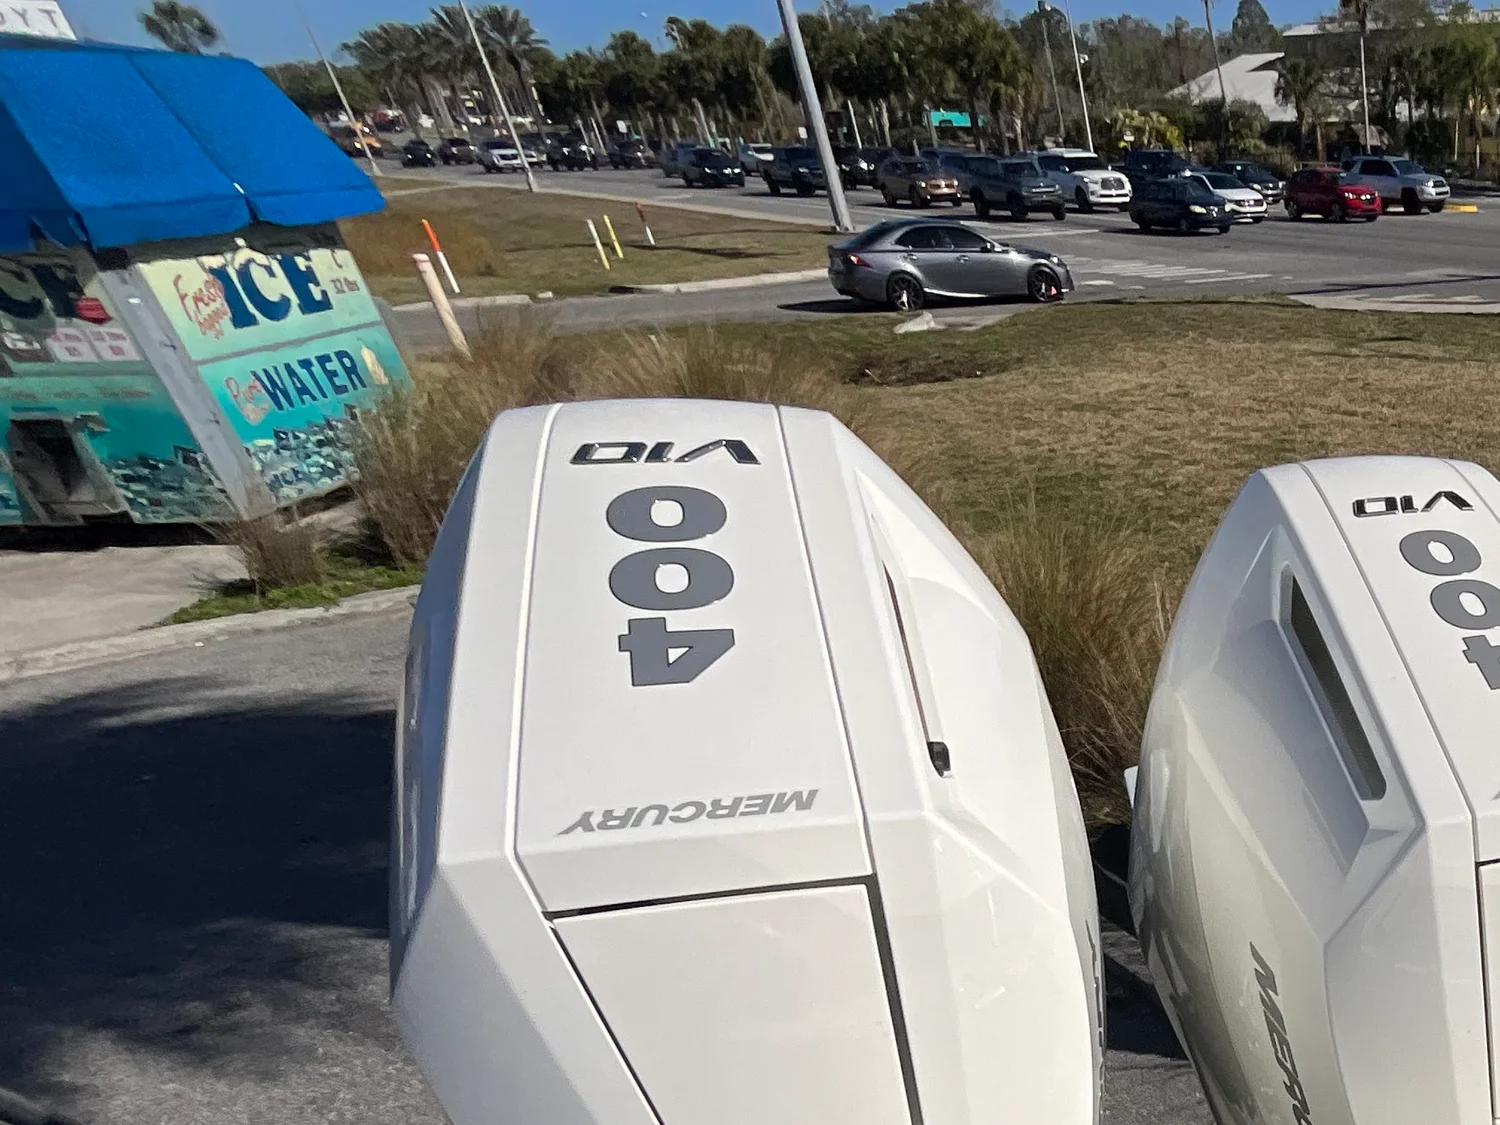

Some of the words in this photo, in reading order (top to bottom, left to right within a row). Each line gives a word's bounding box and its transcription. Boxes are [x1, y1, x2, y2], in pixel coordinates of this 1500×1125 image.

[205, 250, 333, 329] ICE
[250, 350, 367, 411] WATER
[570, 439, 760, 465] V10
[1353, 490, 1475, 518] V10
[606, 486, 736, 687] 400
[559, 788, 819, 835] MERCURY
